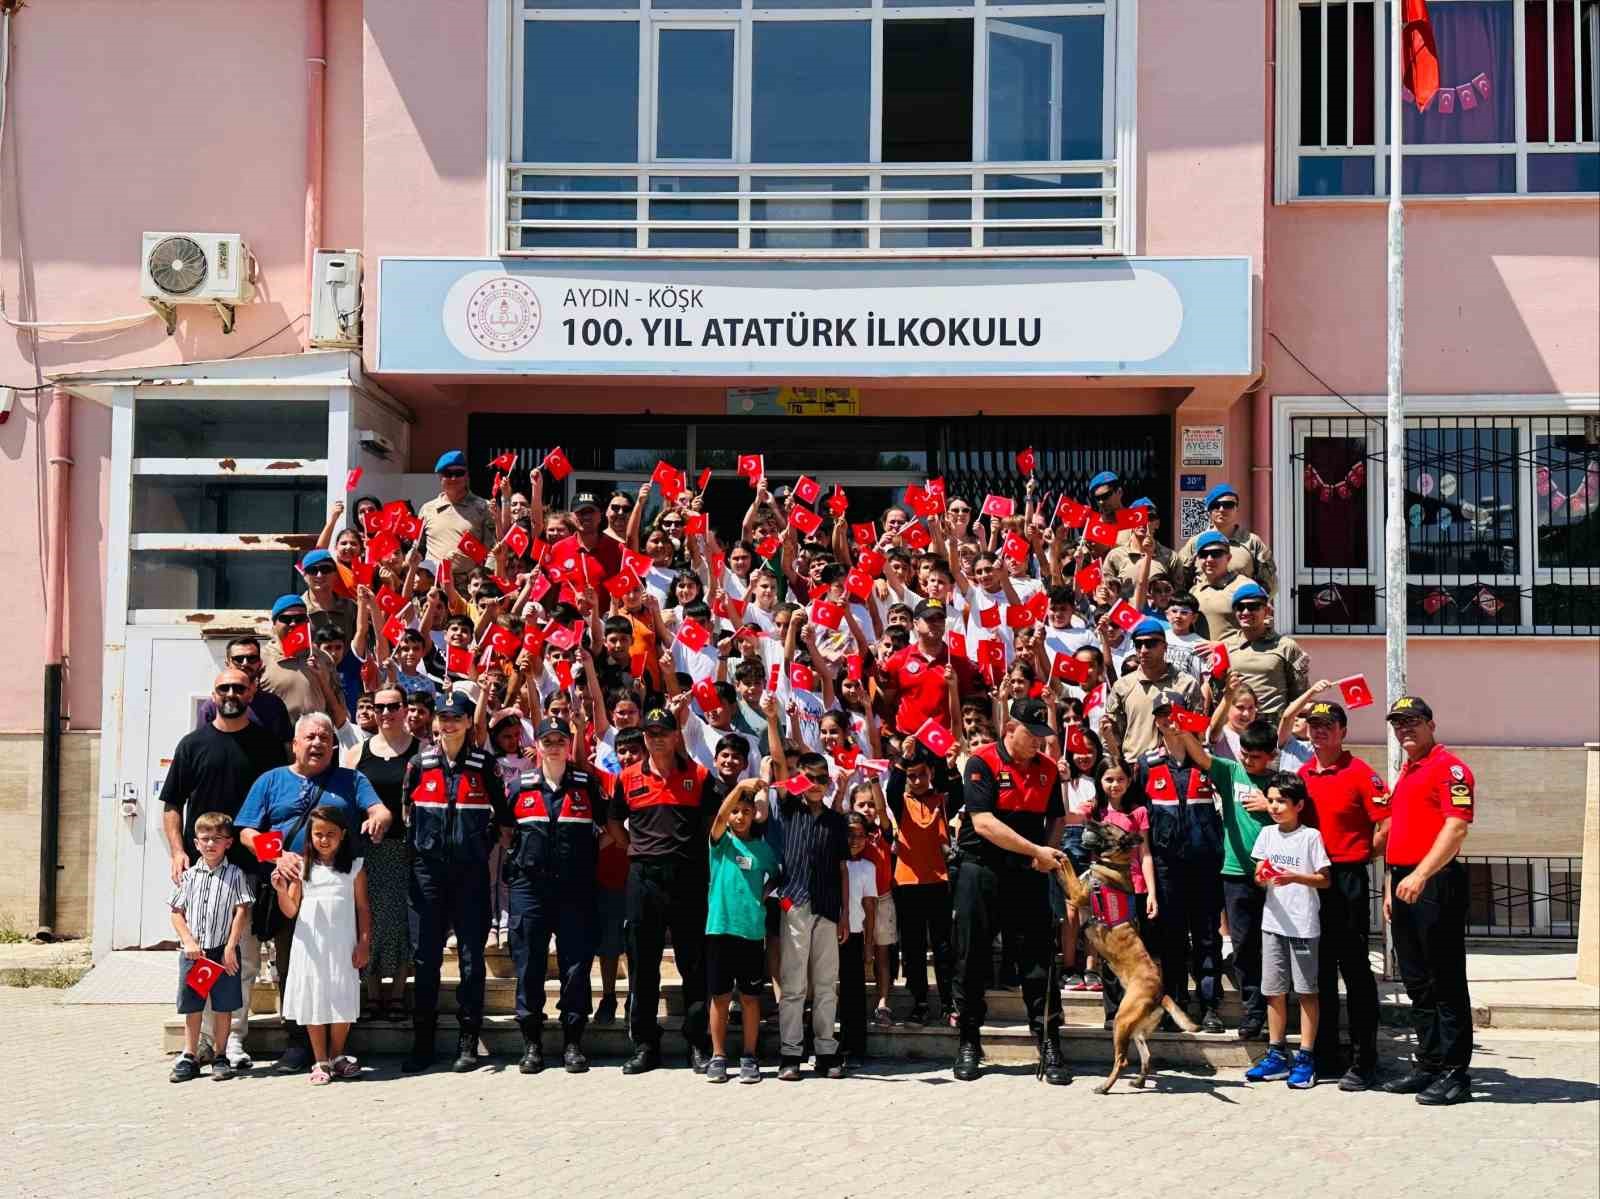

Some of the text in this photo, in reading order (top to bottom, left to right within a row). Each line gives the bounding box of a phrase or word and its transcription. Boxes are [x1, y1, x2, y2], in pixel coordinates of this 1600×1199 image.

[563, 288, 629, 308] AYDIN
[648, 285, 704, 313] KÖŞK
[562, 311, 1042, 347] 100. YIL ATATÜRK İLKOKULU
